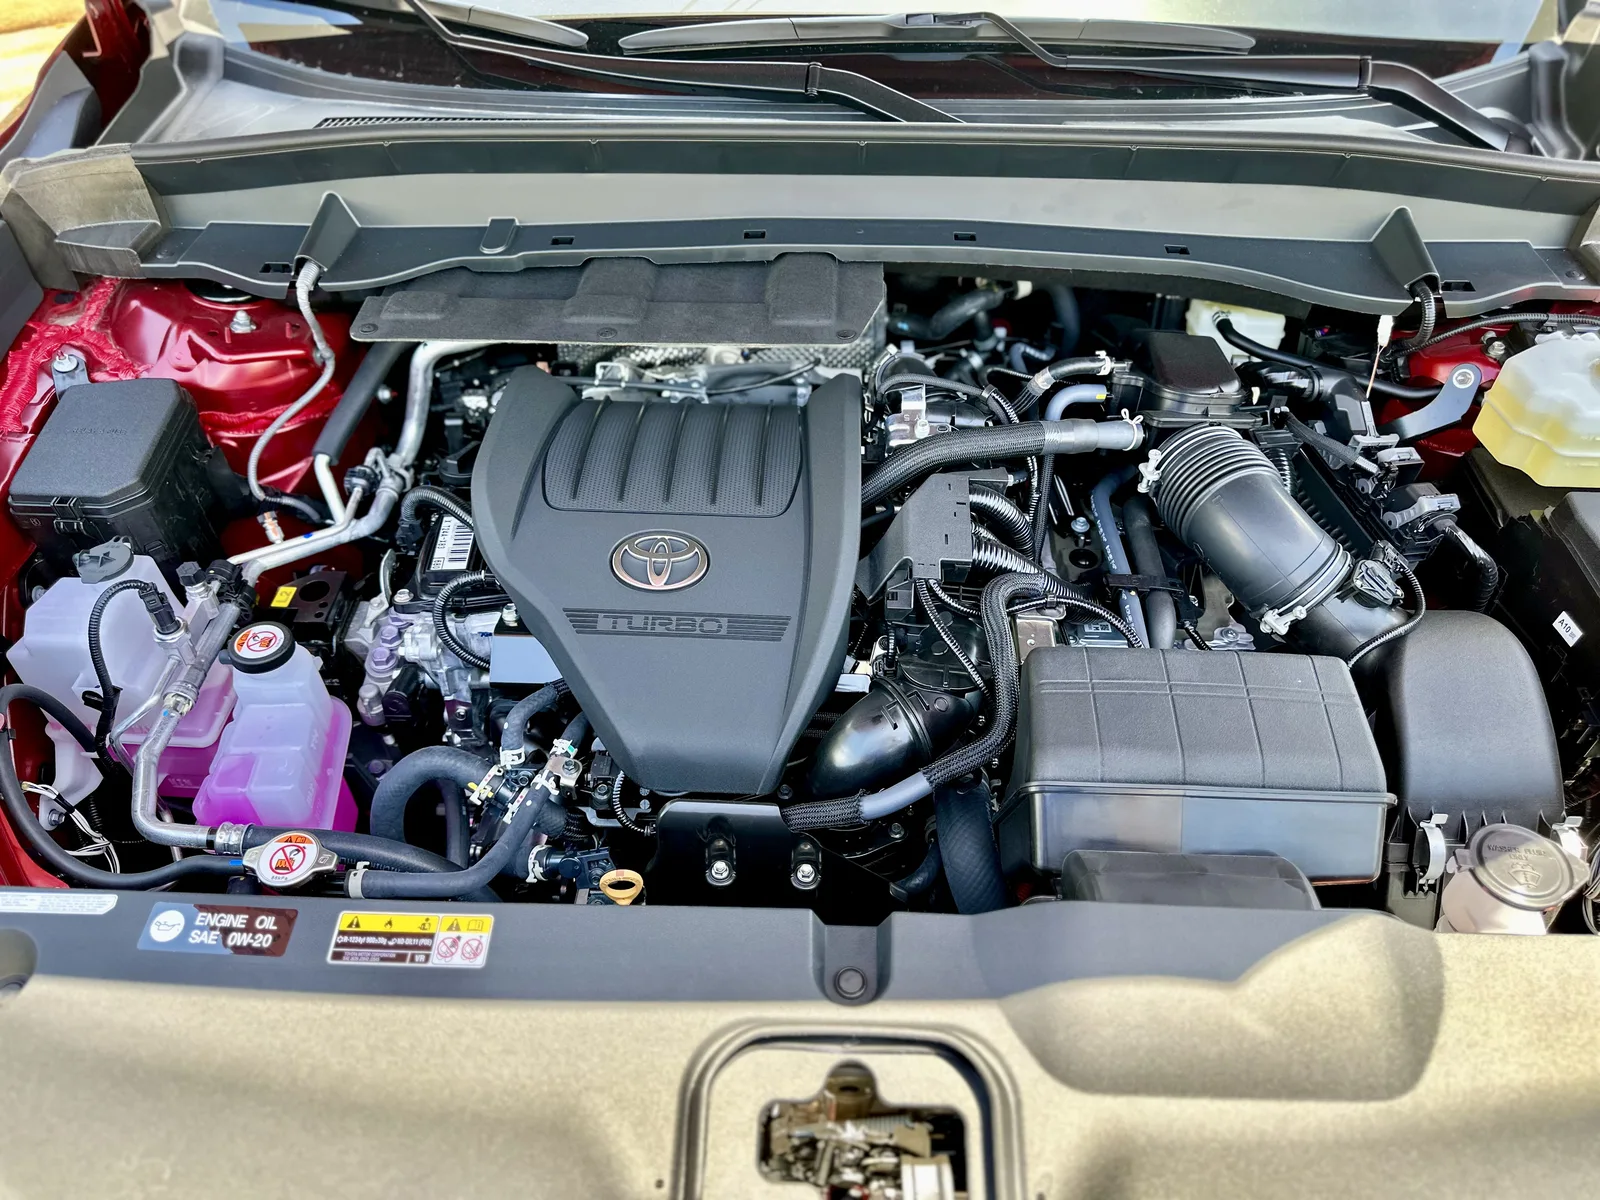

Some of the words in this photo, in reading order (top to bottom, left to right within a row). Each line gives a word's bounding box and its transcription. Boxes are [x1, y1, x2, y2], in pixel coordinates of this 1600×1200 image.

[276, 590, 293, 603] L2
[601, 614, 723, 635] TURBO
[1558, 619, 1572, 633] A10
[1487, 843, 1521, 854] WASHER
[195, 912, 248, 929] ENGINE
[254, 914, 278, 930] OIL
[188, 930, 219, 945] SAE
[227, 932, 273, 948] 0W-20
